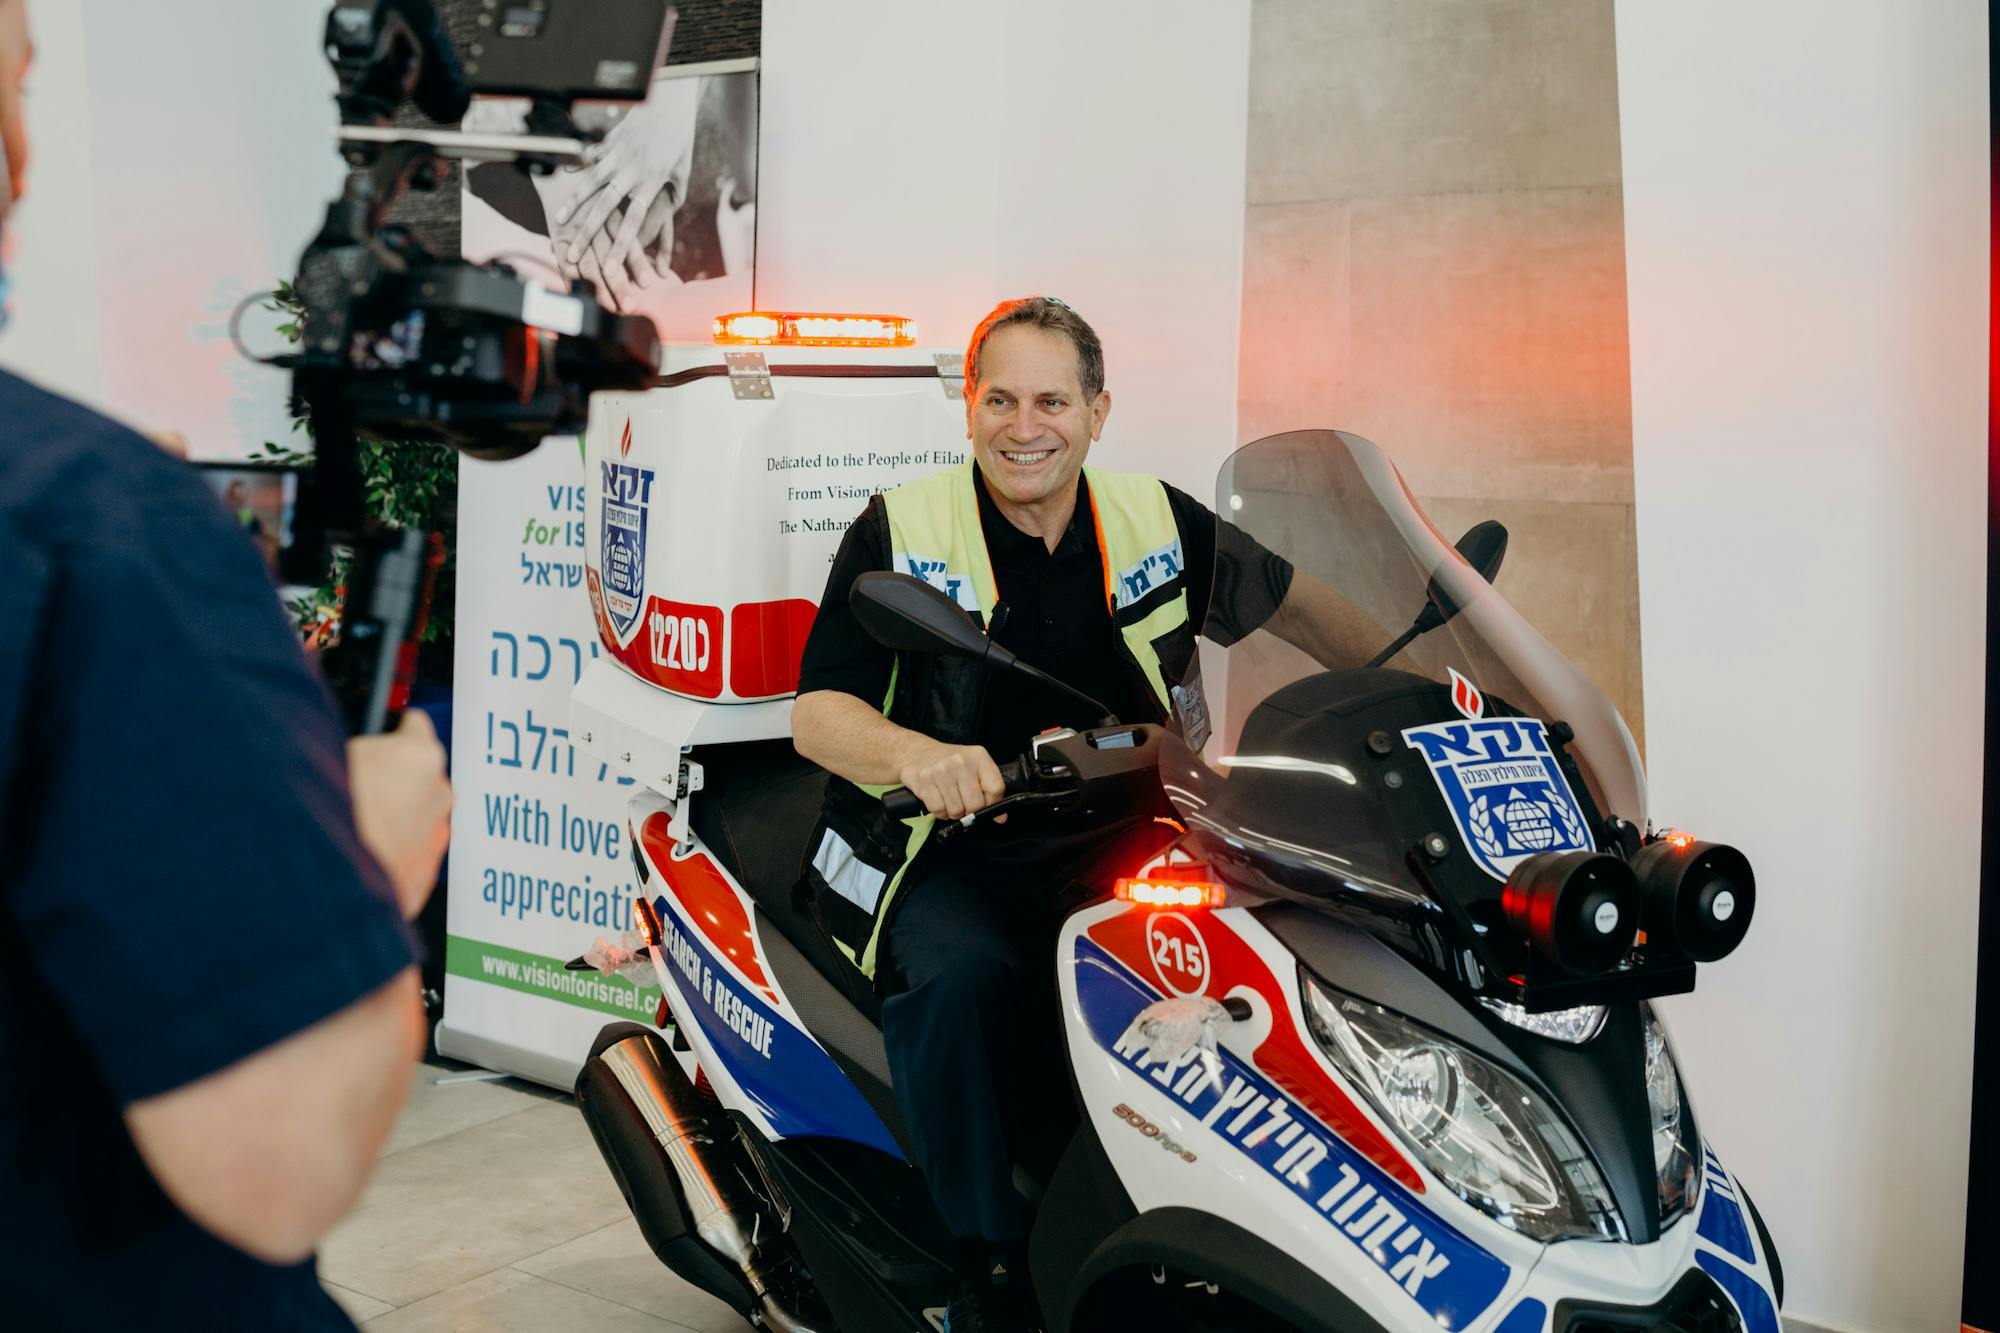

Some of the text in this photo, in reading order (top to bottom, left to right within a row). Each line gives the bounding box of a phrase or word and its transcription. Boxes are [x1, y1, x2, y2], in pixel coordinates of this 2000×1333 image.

[767, 450, 965, 471] Dedicated to the People of Eilat
[547, 485, 584, 512] VIS
[601, 461, 655, 505] זקא
[788, 487, 822, 501] From
[827, 485, 870, 499] Vision
[522, 518, 560, 546] for
[779, 517, 856, 534] The Nathan
[521, 552, 583, 588] שראל
[1408, 721, 1549, 762] זקא
[485, 793, 620, 860] With love
[1508, 818, 1551, 832] ZAKA
[483, 867, 632, 931] appreciati
[1152, 931, 1202, 978] 215
[663, 913, 775, 1059] SEARCH & RESCUE
[1317, 1164, 1450, 1299] איתור
